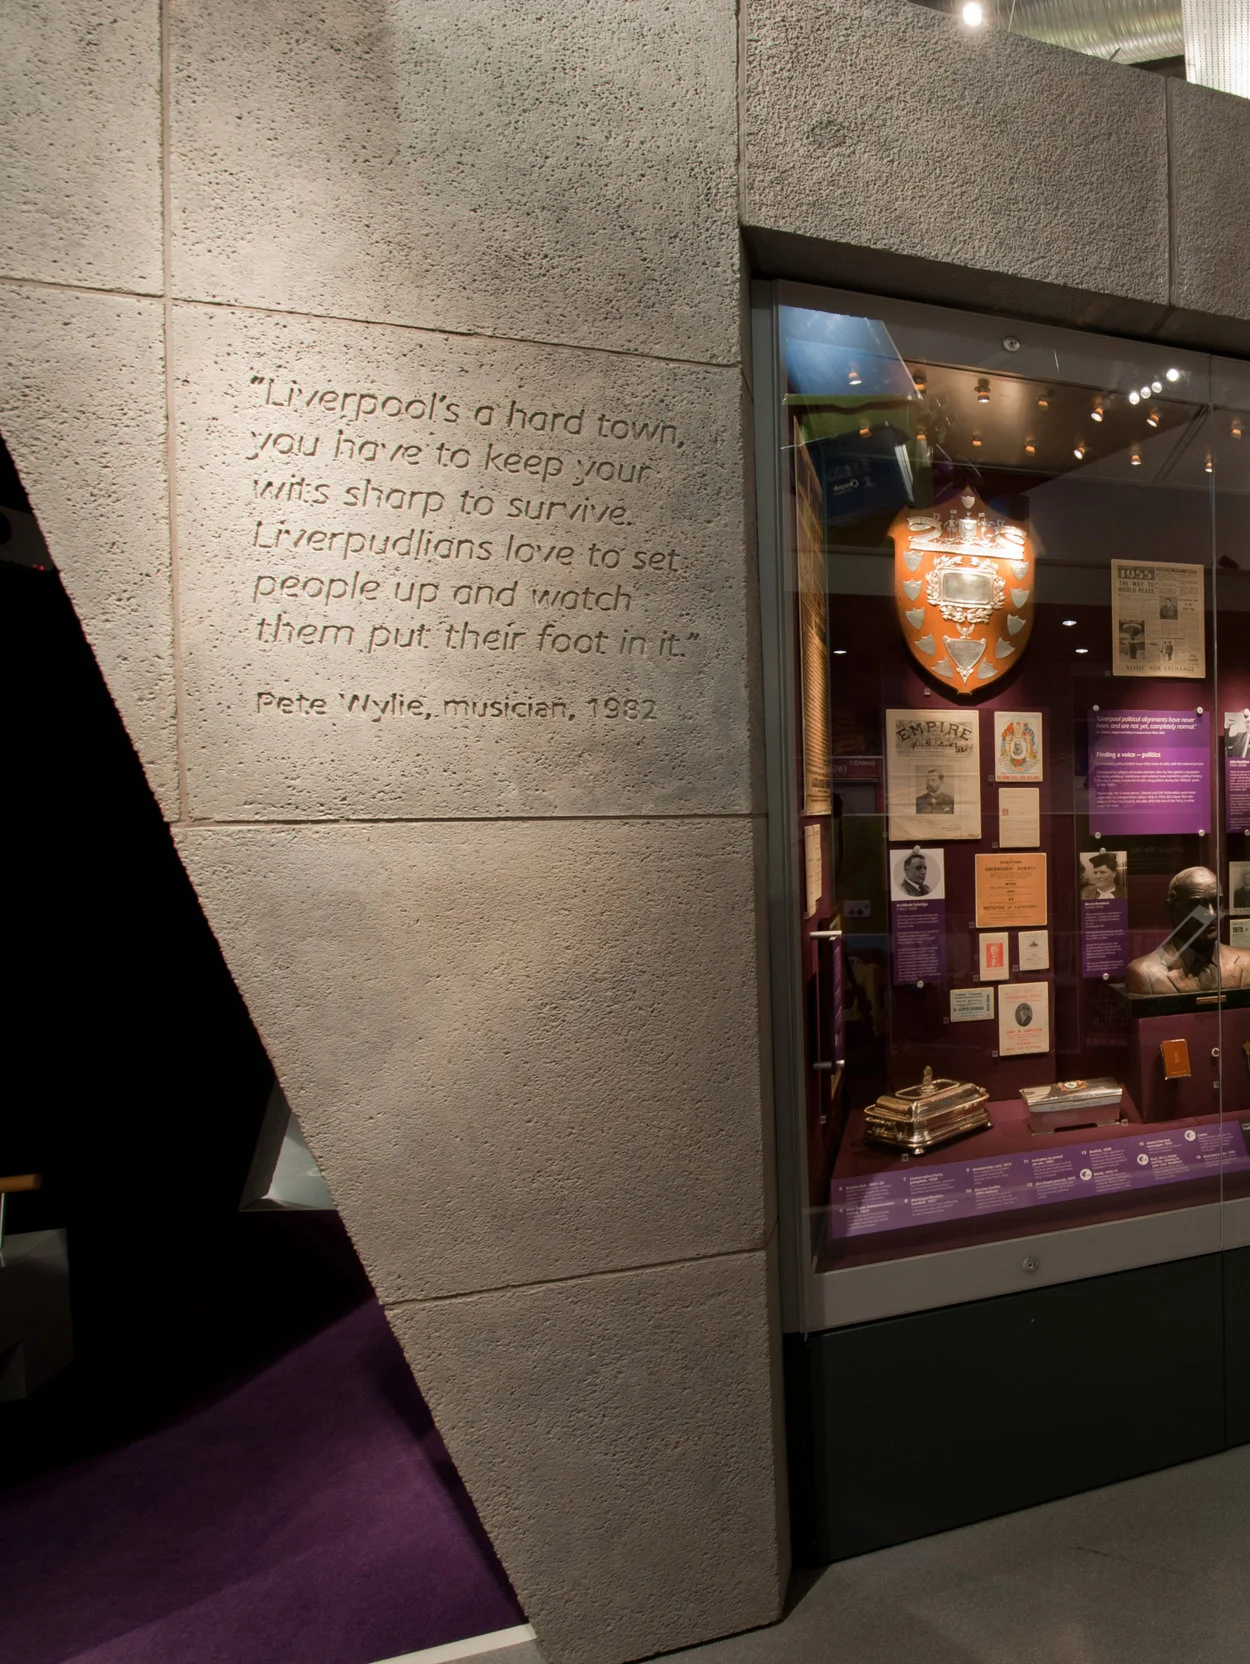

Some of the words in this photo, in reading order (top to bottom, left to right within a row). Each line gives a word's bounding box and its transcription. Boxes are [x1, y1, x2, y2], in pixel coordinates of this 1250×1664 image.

[474, 405, 493, 426] a
[507, 401, 585, 436] hard
[597, 412, 686, 448] town,
[247, 430, 320, 460] you
[335, 430, 420, 466] have
[437, 444, 470, 469] to
[485, 444, 563, 479] keep
[576, 459, 653, 487] your
[253, 474, 328, 506] wits
[344, 479, 445, 518] sharp
[460, 490, 495, 517] to
[507, 496, 633, 527] survive.
[252, 521, 493, 561] Liverpudlians
[506, 534, 575, 565] love
[588, 545, 622, 570] to
[632, 549, 680, 573] set
[252, 571, 381, 606] people
[395, 581, 439, 609] up
[453, 579, 518, 609] and
[532, 584, 633, 612] watch
[1119, 580, 1131, 588] THE
[1132, 580, 1145, 588] WAY
[1120, 568, 1153, 580] 1955
[257, 614, 355, 646] them
[368, 624, 429, 653] put
[445, 621, 526, 651] their
[537, 623, 607, 656] foot
[619, 628, 647, 657] in
[257, 691, 327, 716] Pete
[340, 692, 431, 722] Wylie,
[443, 696, 576, 722] musician,
[589, 698, 658, 720] 1982
[1141, 716, 1168, 724] alignments
[896, 721, 973, 742] EMPIRE
